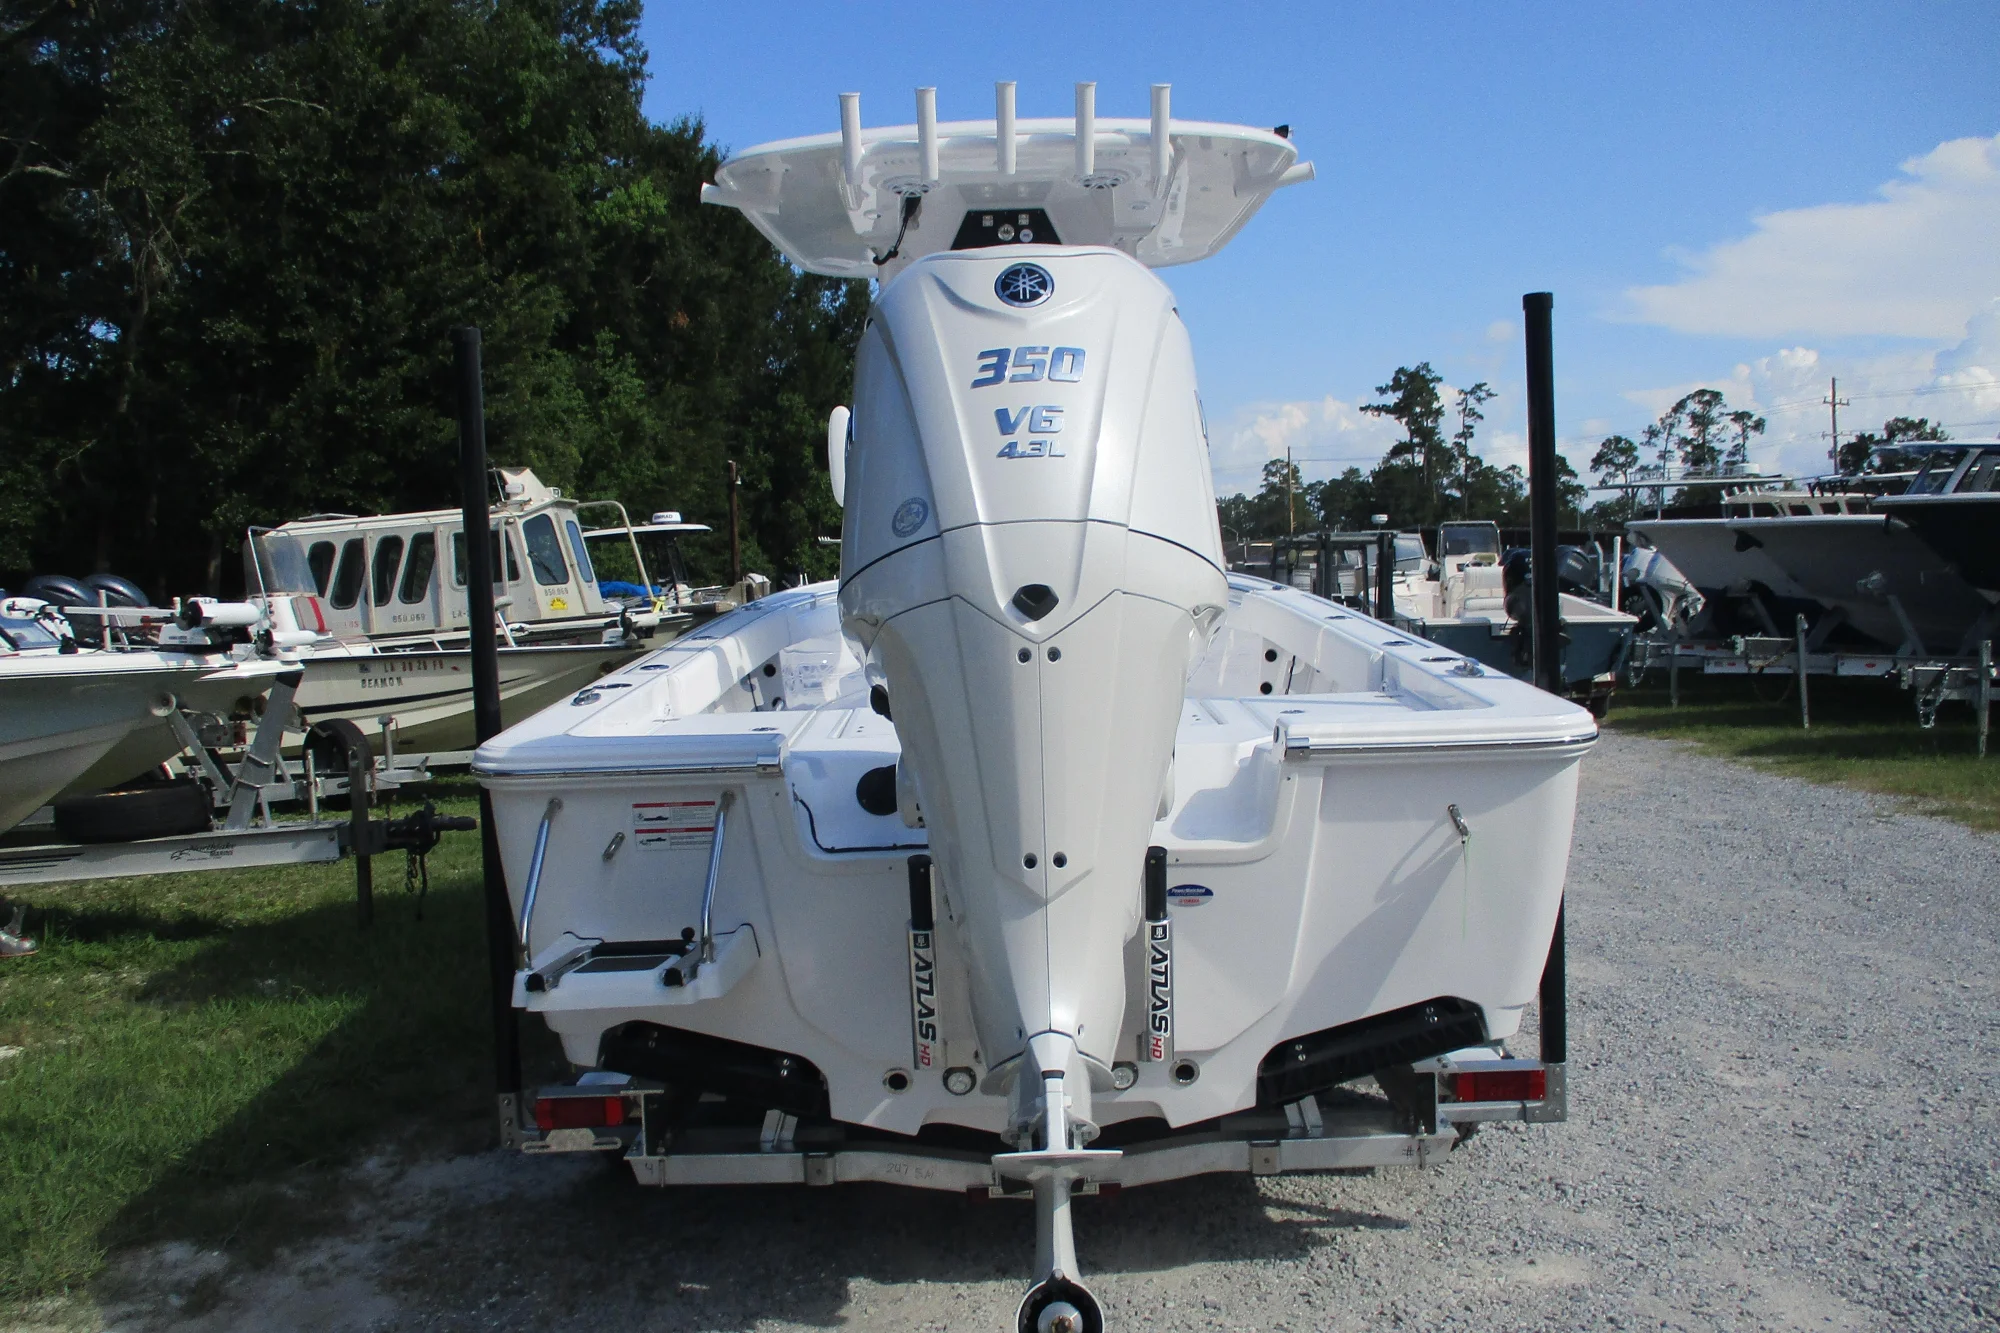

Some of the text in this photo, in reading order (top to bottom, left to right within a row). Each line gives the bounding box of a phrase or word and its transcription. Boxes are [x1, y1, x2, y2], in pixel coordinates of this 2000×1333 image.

[970, 346, 1086, 389] 350
[994, 405, 1064, 436] V6
[996, 440, 1066, 459] 4.3L
[914, 950, 936, 1067] ATLAS HD
[1151, 943, 1169, 1059] ATLAS HD
